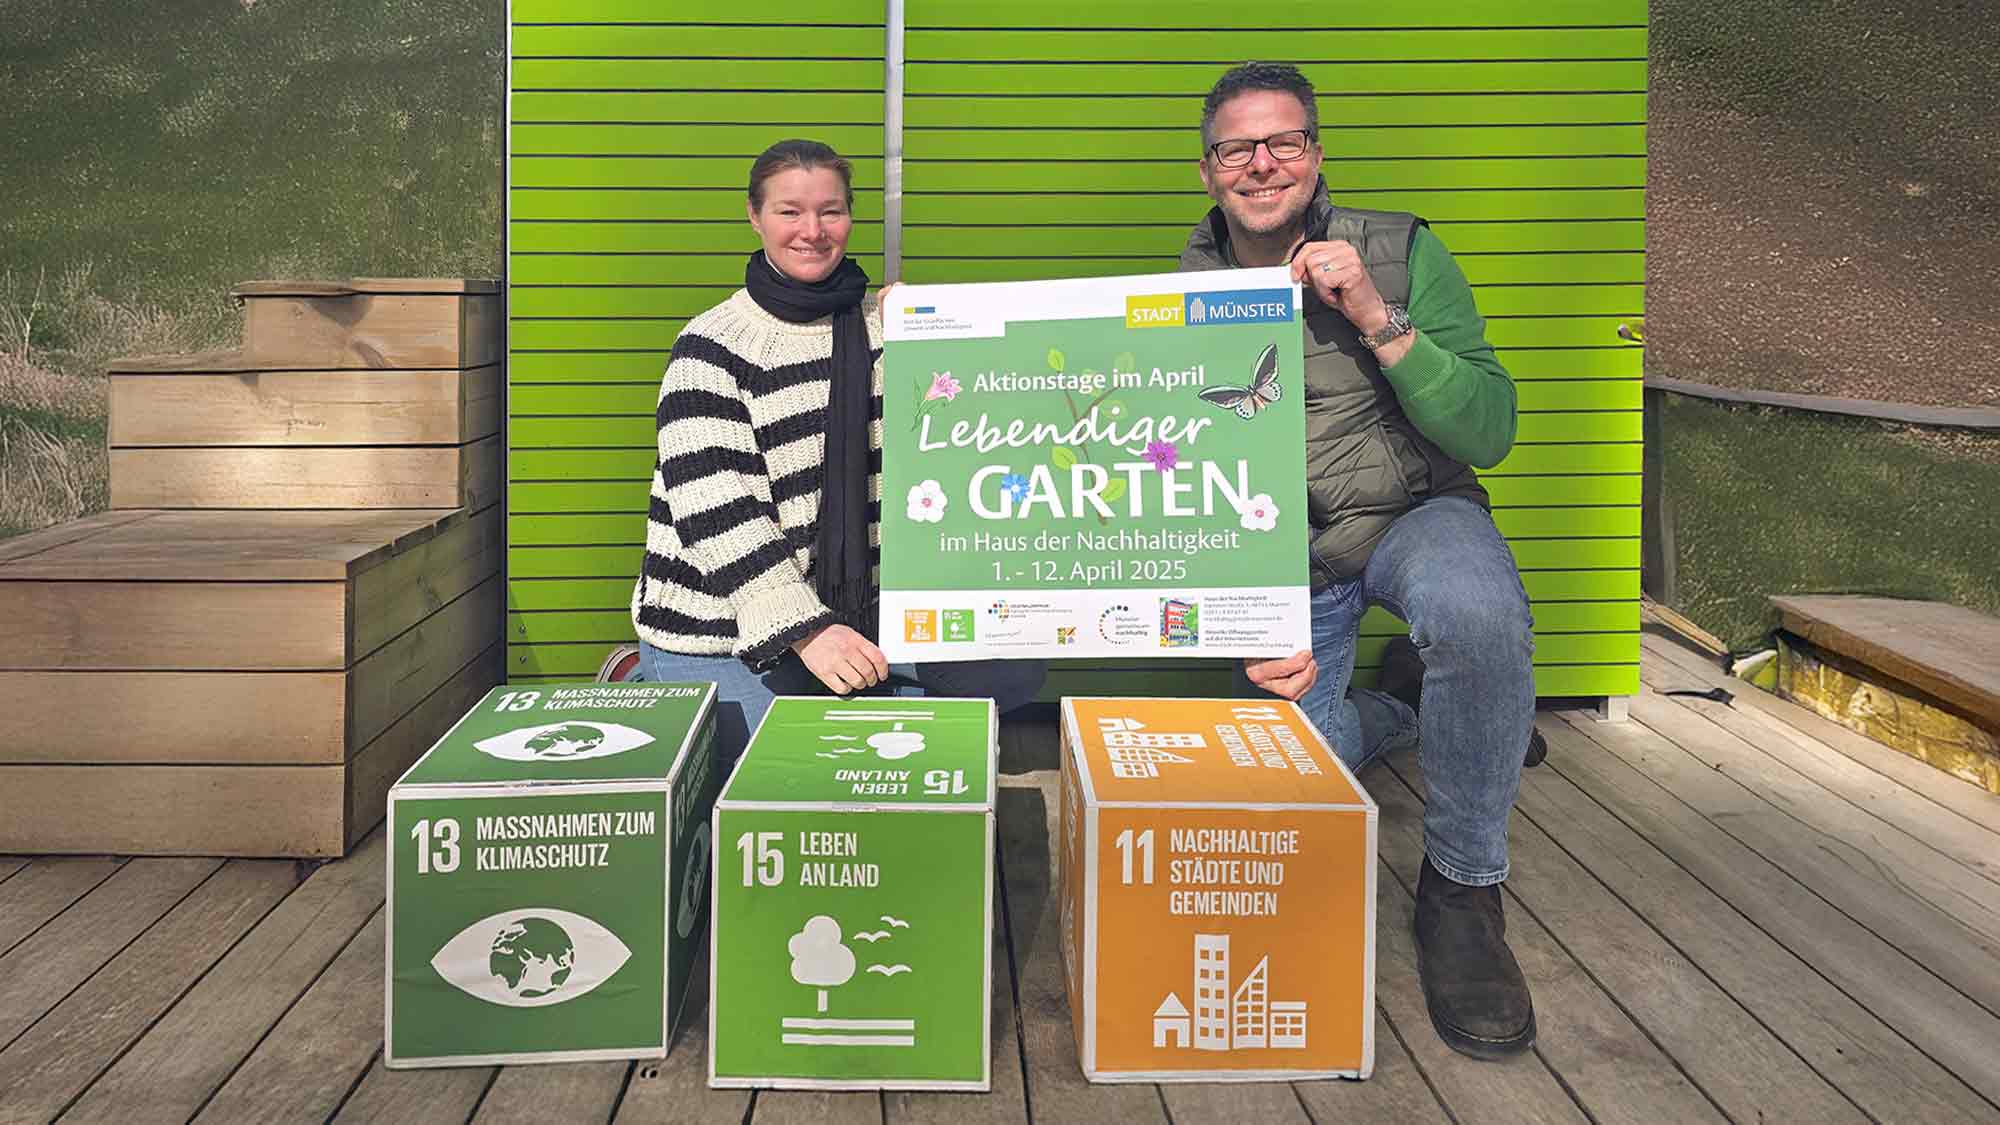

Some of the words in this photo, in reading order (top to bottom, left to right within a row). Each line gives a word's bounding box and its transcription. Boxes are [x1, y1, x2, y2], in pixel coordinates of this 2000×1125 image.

[1132, 306, 1181, 323] STADT
[1209, 301, 1286, 319] MÜNSTER
[973, 369, 1106, 394] Aktionstage
[1112, 368, 1142, 388] im
[1148, 365, 1206, 392] April
[918, 405, 1213, 457] Lebendiger
[968, 459, 1249, 520] GARTEN
[940, 532, 967, 552] im
[974, 532, 1027, 552] Haus
[1033, 530, 1071, 552] der
[1077, 528, 1240, 555] Nachhaltigkeit
[1031, 560, 1064, 581] 12.
[1069, 559, 1123, 585] April
[1130, 559, 1187, 581] 2025
[494, 690, 541, 713] 13
[552, 687, 668, 699] MASSNAHMEN
[665, 687, 701, 698] ZUM
[543, 698, 658, 711] KLIMASCHUTZ
[835, 769, 882, 781] LAND
[885, 770, 911, 782] AN
[923, 769, 970, 795] 15
[851, 783, 909, 795] LEBEN
[411, 818, 461, 874] 13
[476, 814, 612, 842] MASSNAHMEN
[615, 811, 655, 836] ZUM
[476, 843, 609, 871] KLIMASCHUTZ
[736, 831, 785, 887] 15
[799, 831, 857, 857] LEBEN
[1115, 829, 1155, 885] 11
[1170, 829, 1299, 855] NACHHALTIGE
[799, 862, 826, 887] AN
[829, 863, 880, 888] LAND
[1170, 857, 1241, 884] STÄDTE
[1244, 860, 1284, 885] UND
[1169, 890, 1278, 916] GEMEINDEN
